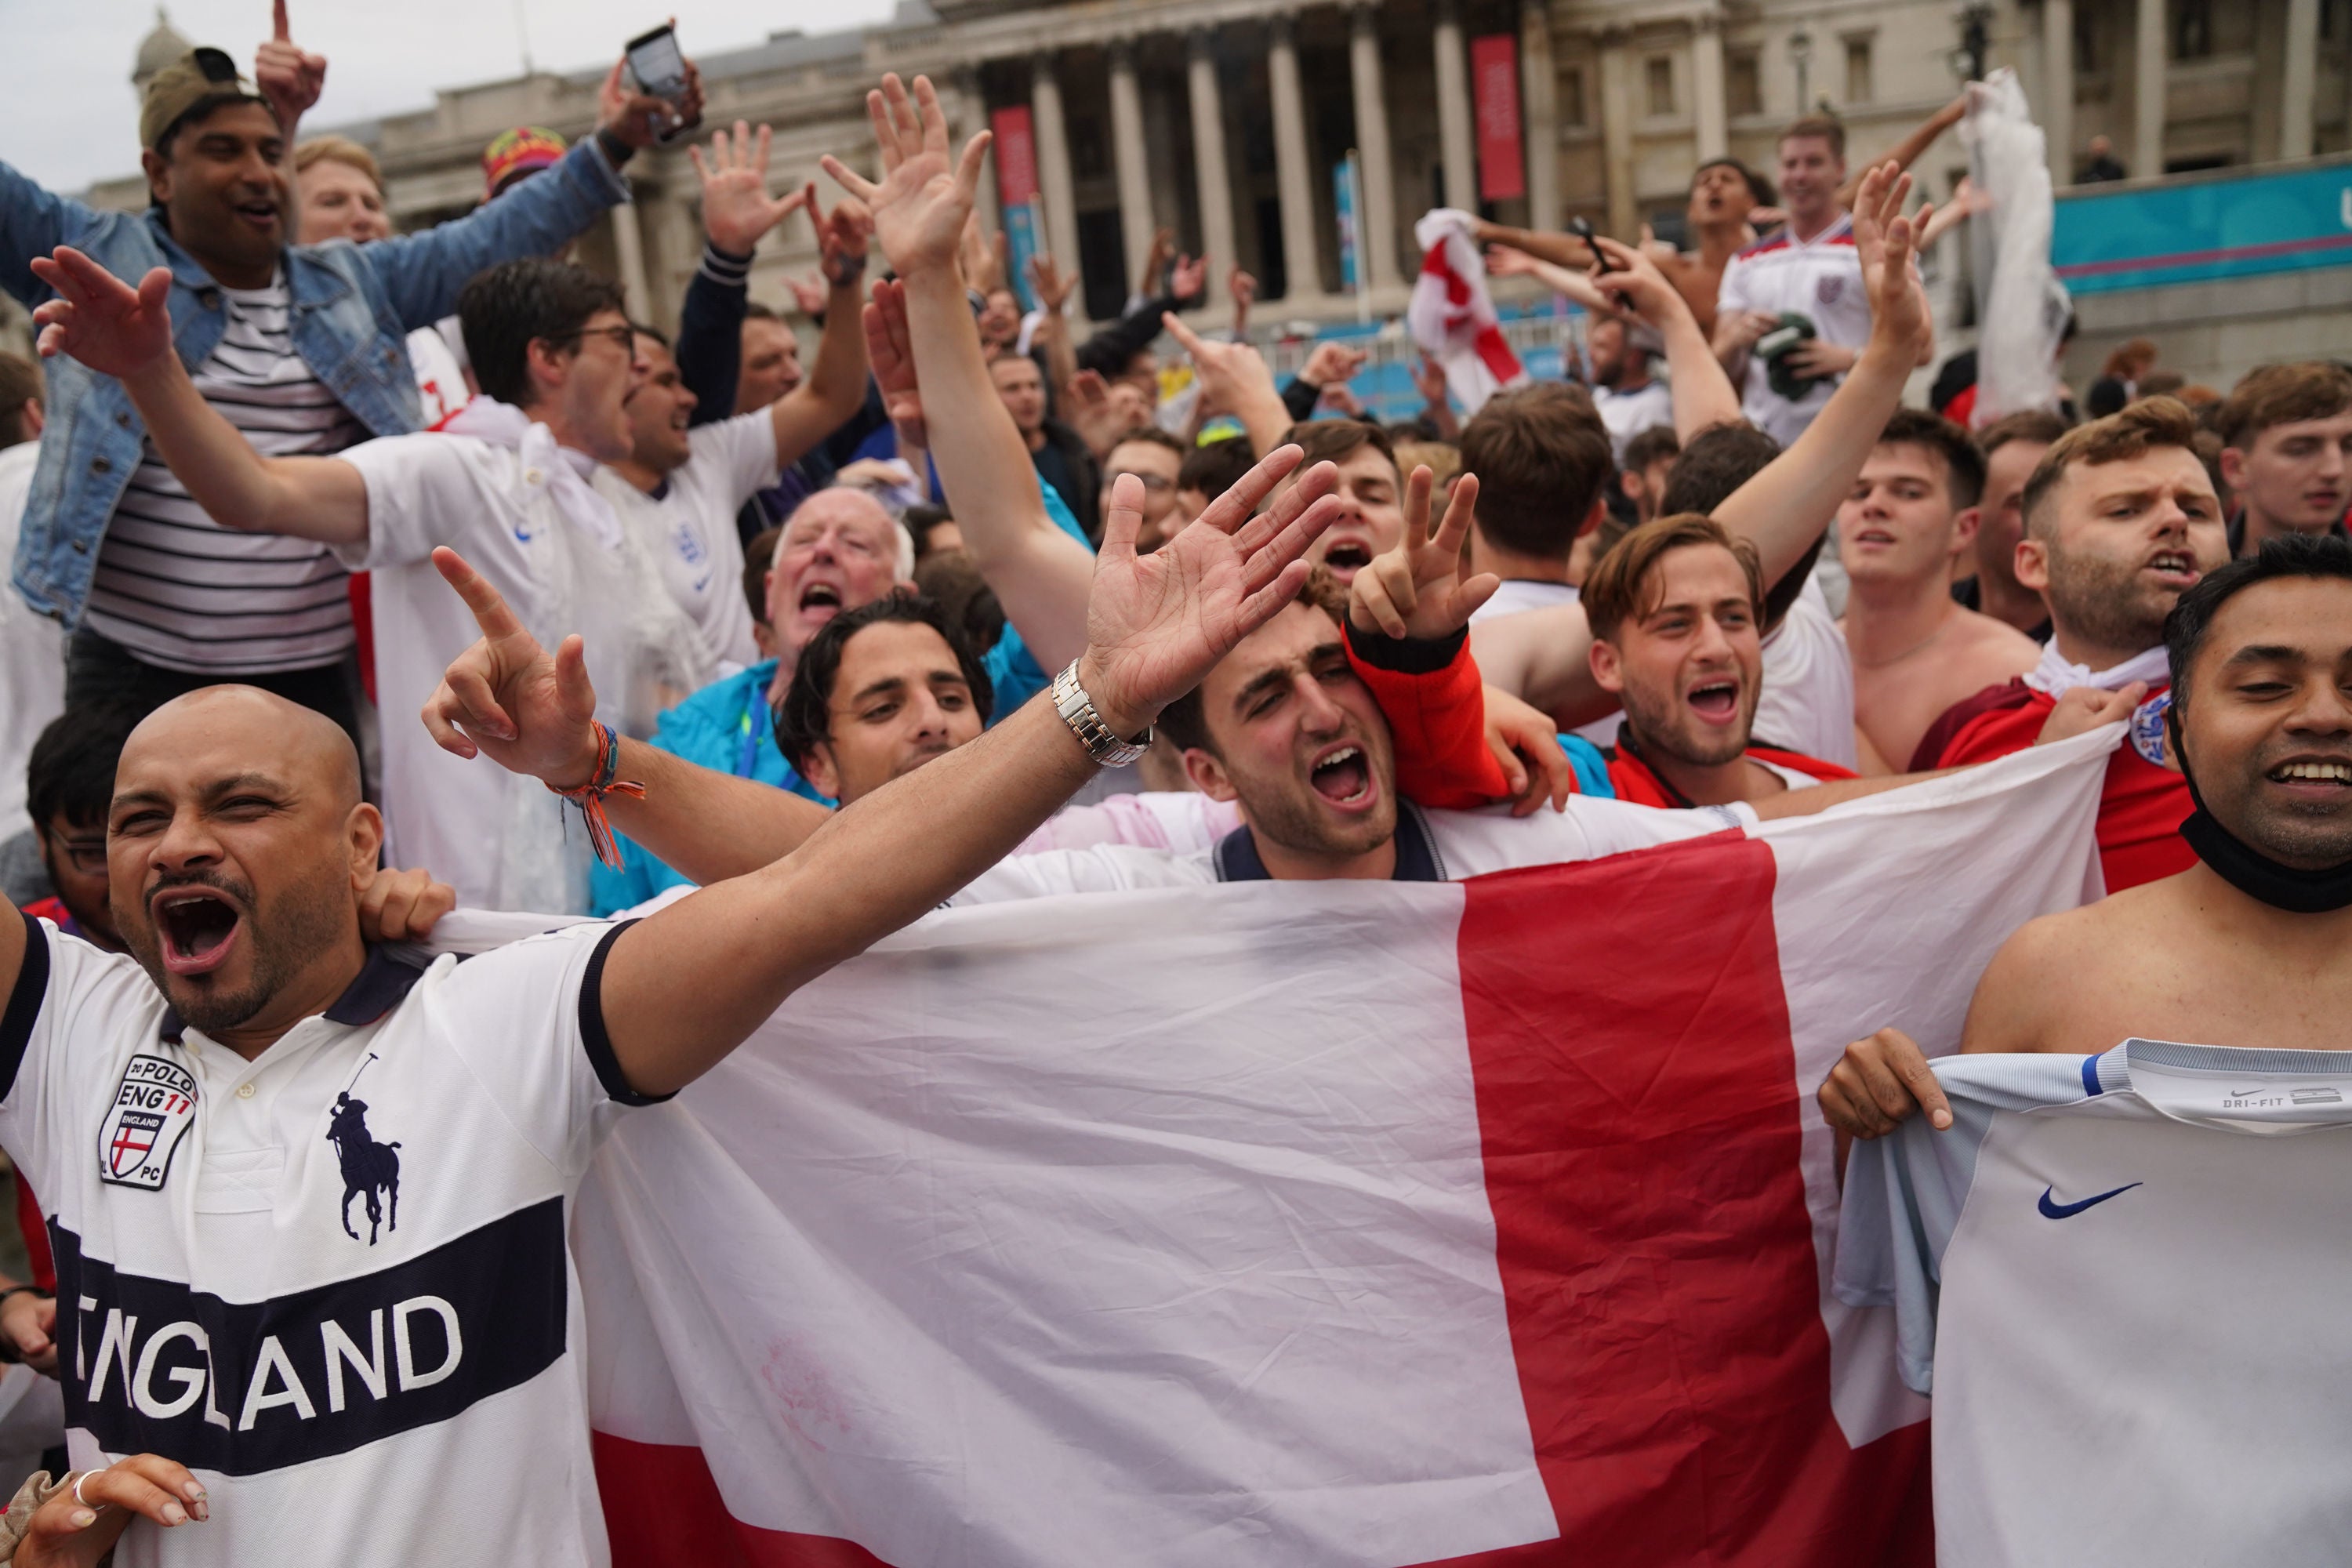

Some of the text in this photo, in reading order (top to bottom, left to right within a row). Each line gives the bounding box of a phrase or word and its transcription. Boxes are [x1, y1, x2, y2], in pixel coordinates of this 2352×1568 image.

[131, 1064, 142, 1073] 20
[141, 1062, 193, 1092] POLO
[2223, 1098, 2283, 1108] DRI-FIT
[122, 1115, 160, 1127] ENGLAND
[140, 1166, 160, 1181] PC
